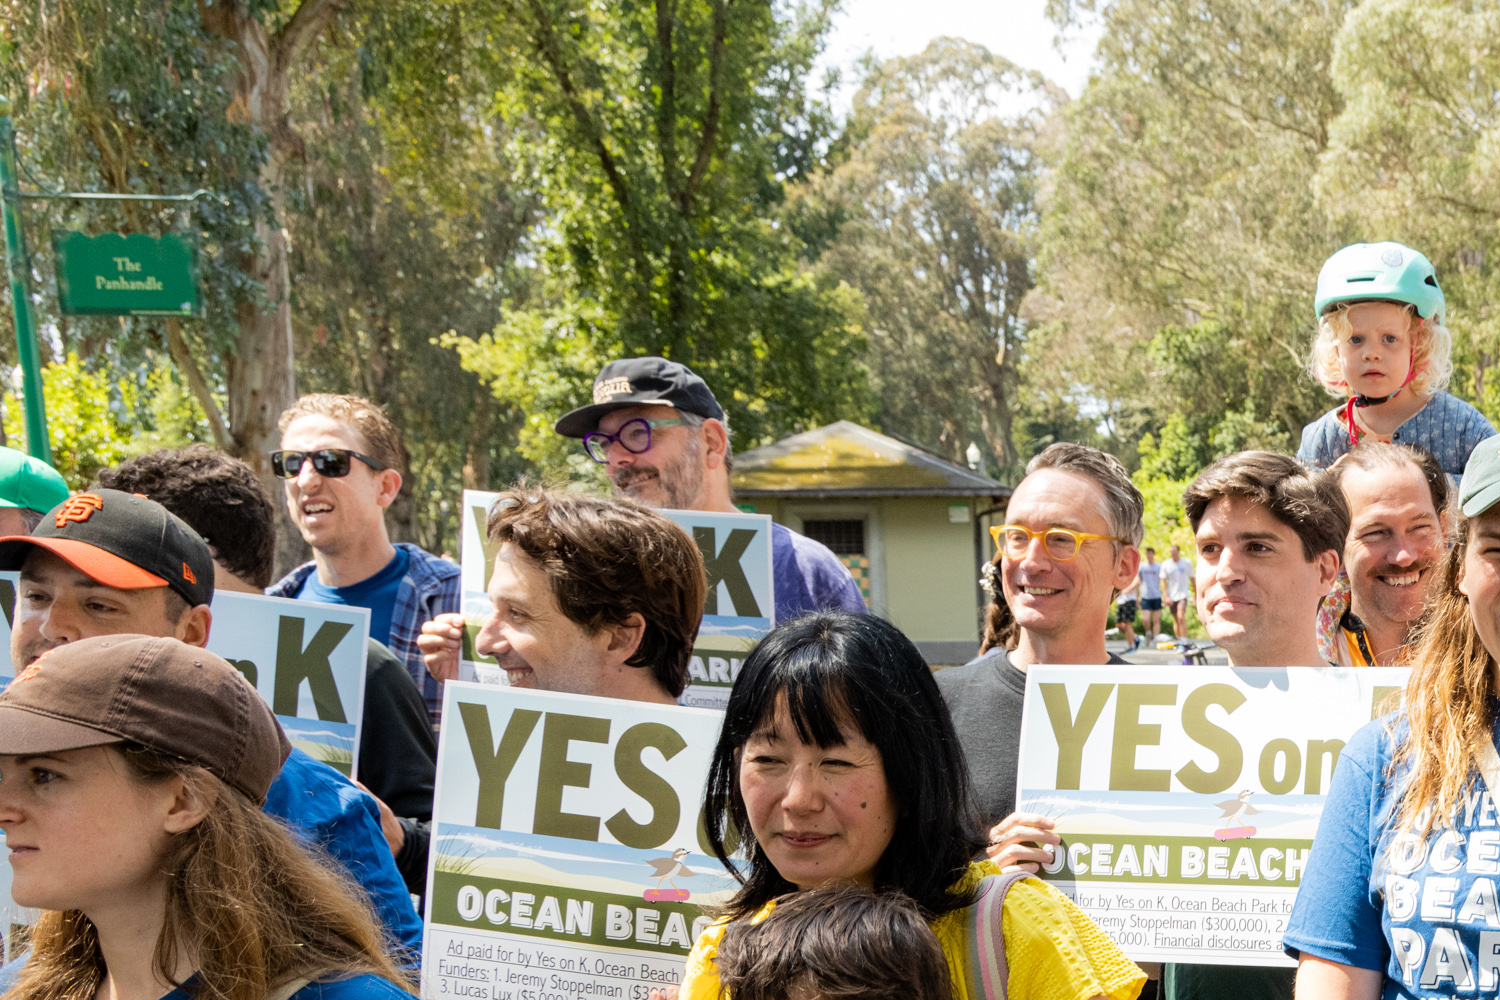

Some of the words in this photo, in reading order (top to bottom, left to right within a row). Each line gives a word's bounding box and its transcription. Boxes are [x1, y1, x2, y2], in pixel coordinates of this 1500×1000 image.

[95, 275, 164, 291] Panhandle
[112, 257, 142, 272] The
[692, 526, 762, 618] K
[274, 615, 354, 724] K
[688, 655, 746, 683] AR
[1038, 683, 1245, 795] YES
[1258, 739, 1341, 796] on
[459, 703, 684, 849] YES
[1041, 843, 1169, 877] OCEAN
[1181, 846, 1310, 881] BEACH
[457, 885, 594, 936] OCEAN
[1079, 893, 1095, 907] for
[1099, 894, 1112, 912] by
[1116, 894, 1135, 909] Yes
[1138, 899, 1152, 909] on
[1157, 896, 1167, 911] K,
[1171, 896, 1208, 912] Ocean
[1212, 897, 1247, 913] Beach
[1252, 898, 1278, 913] Park
